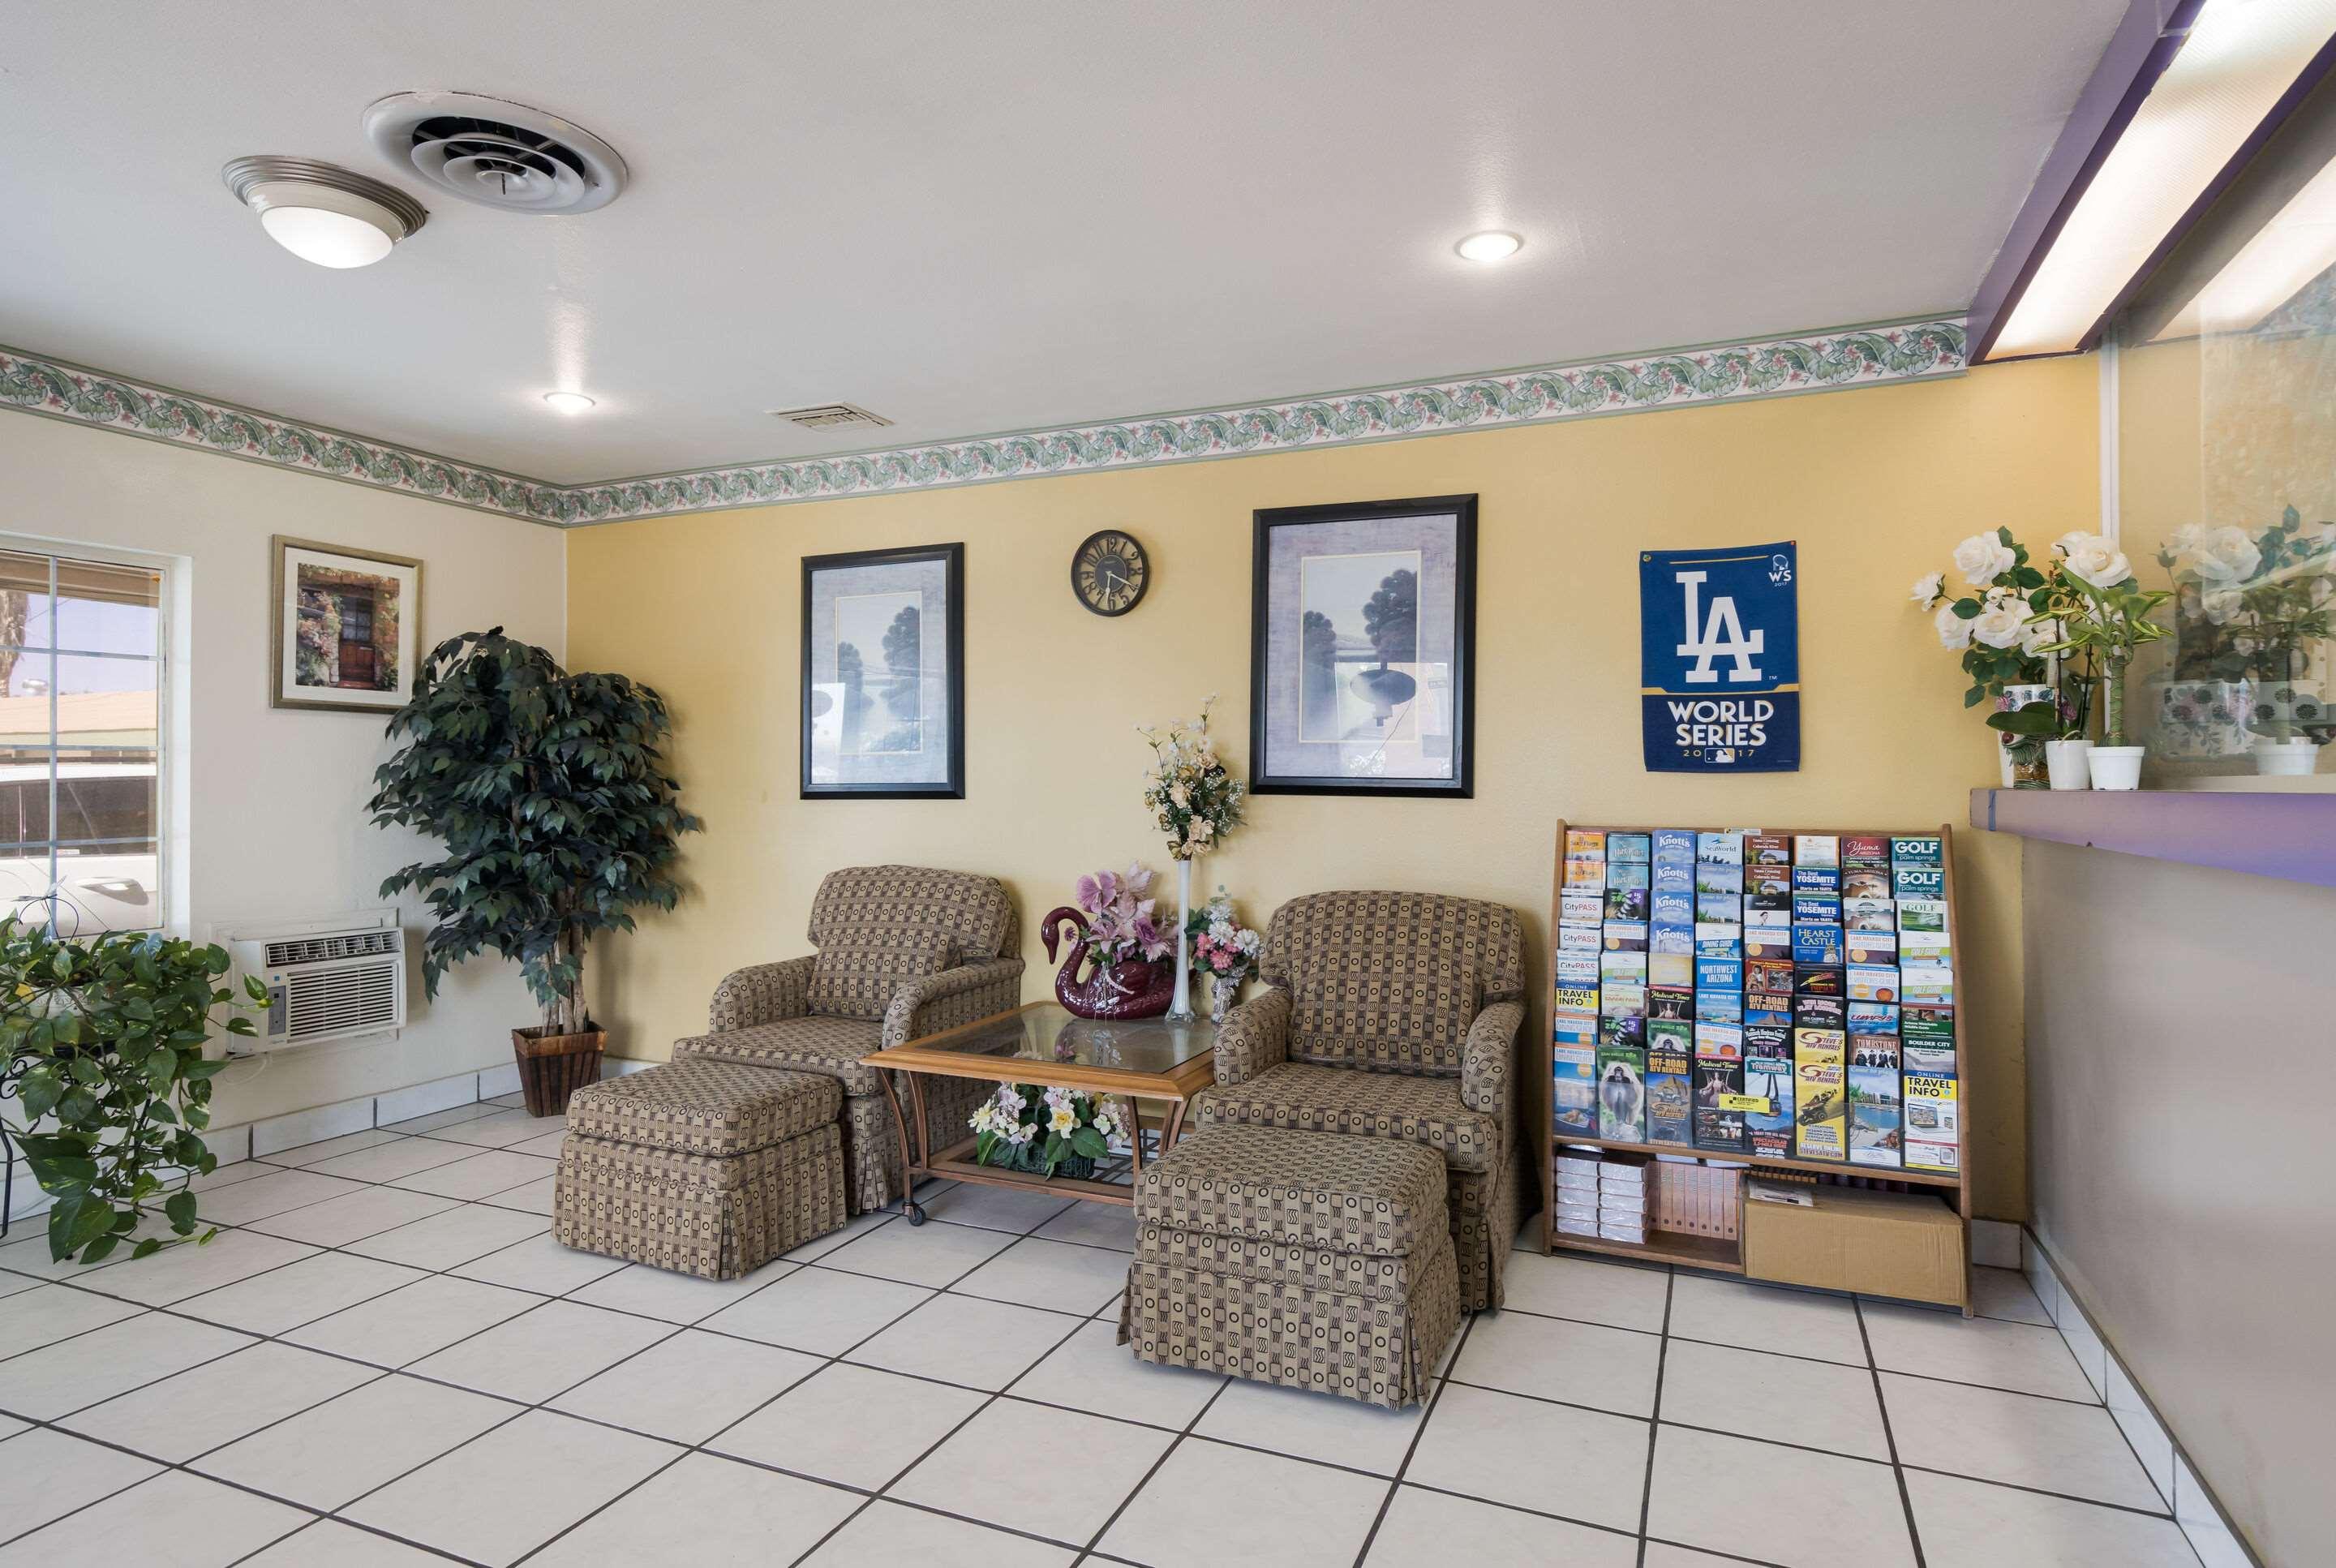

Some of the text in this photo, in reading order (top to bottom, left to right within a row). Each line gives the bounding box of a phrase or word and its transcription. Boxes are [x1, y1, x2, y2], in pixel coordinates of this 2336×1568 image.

[1106, 536, 1117, 555] 12
[1769, 569, 1792, 582] WS
[1676, 570, 1764, 682] LA
[1668, 700, 1774, 723] WORLD
[1676, 723, 1767, 746] SERIES
[1659, 835, 1690, 848] Knott's
[1847, 841, 1880, 856] Yuma
[1895, 841, 1938, 853] GOLF
[1657, 866, 1689, 879] Knott's
[1797, 875, 1836, 883] YOSEMITE
[1897, 872, 1940, 885] GOLF
[1565, 903, 1597, 911] CityPASS
[1655, 896, 1689, 909] Knott's
[1906, 903, 1935, 912] GOLF
[1797, 906, 1837, 915] YOSEMITE
[1563, 934, 1596, 943] CityPASS
[1656, 927, 1690, 942] Knott's
[1798, 929, 1836, 938] HEARST
[1720, 939, 1734, 947] GUIDE
[1801, 937, 1836, 946] CASTLE
[1700, 964, 1738, 974] NORTHWEST
[1706, 973, 1733, 983] ARIZONA
[1557, 990, 1593, 999] TRAVEL
[1559, 998, 1584, 1006] INFO
[1749, 994, 1788, 1006] OFF-ROAD
[1761, 1004, 1788, 1012] RENTALS
[1857, 1039, 1896, 1049] TOMBSTONE
[1649, 1058, 1687, 1068] OFF-ROAD
[1751, 1063, 1786, 1072] Tramway
[1661, 1067, 1687, 1075] RENTALS
[1908, 1077, 1952, 1089] TRAVEL
[1909, 1086, 1940, 1097] INFO
